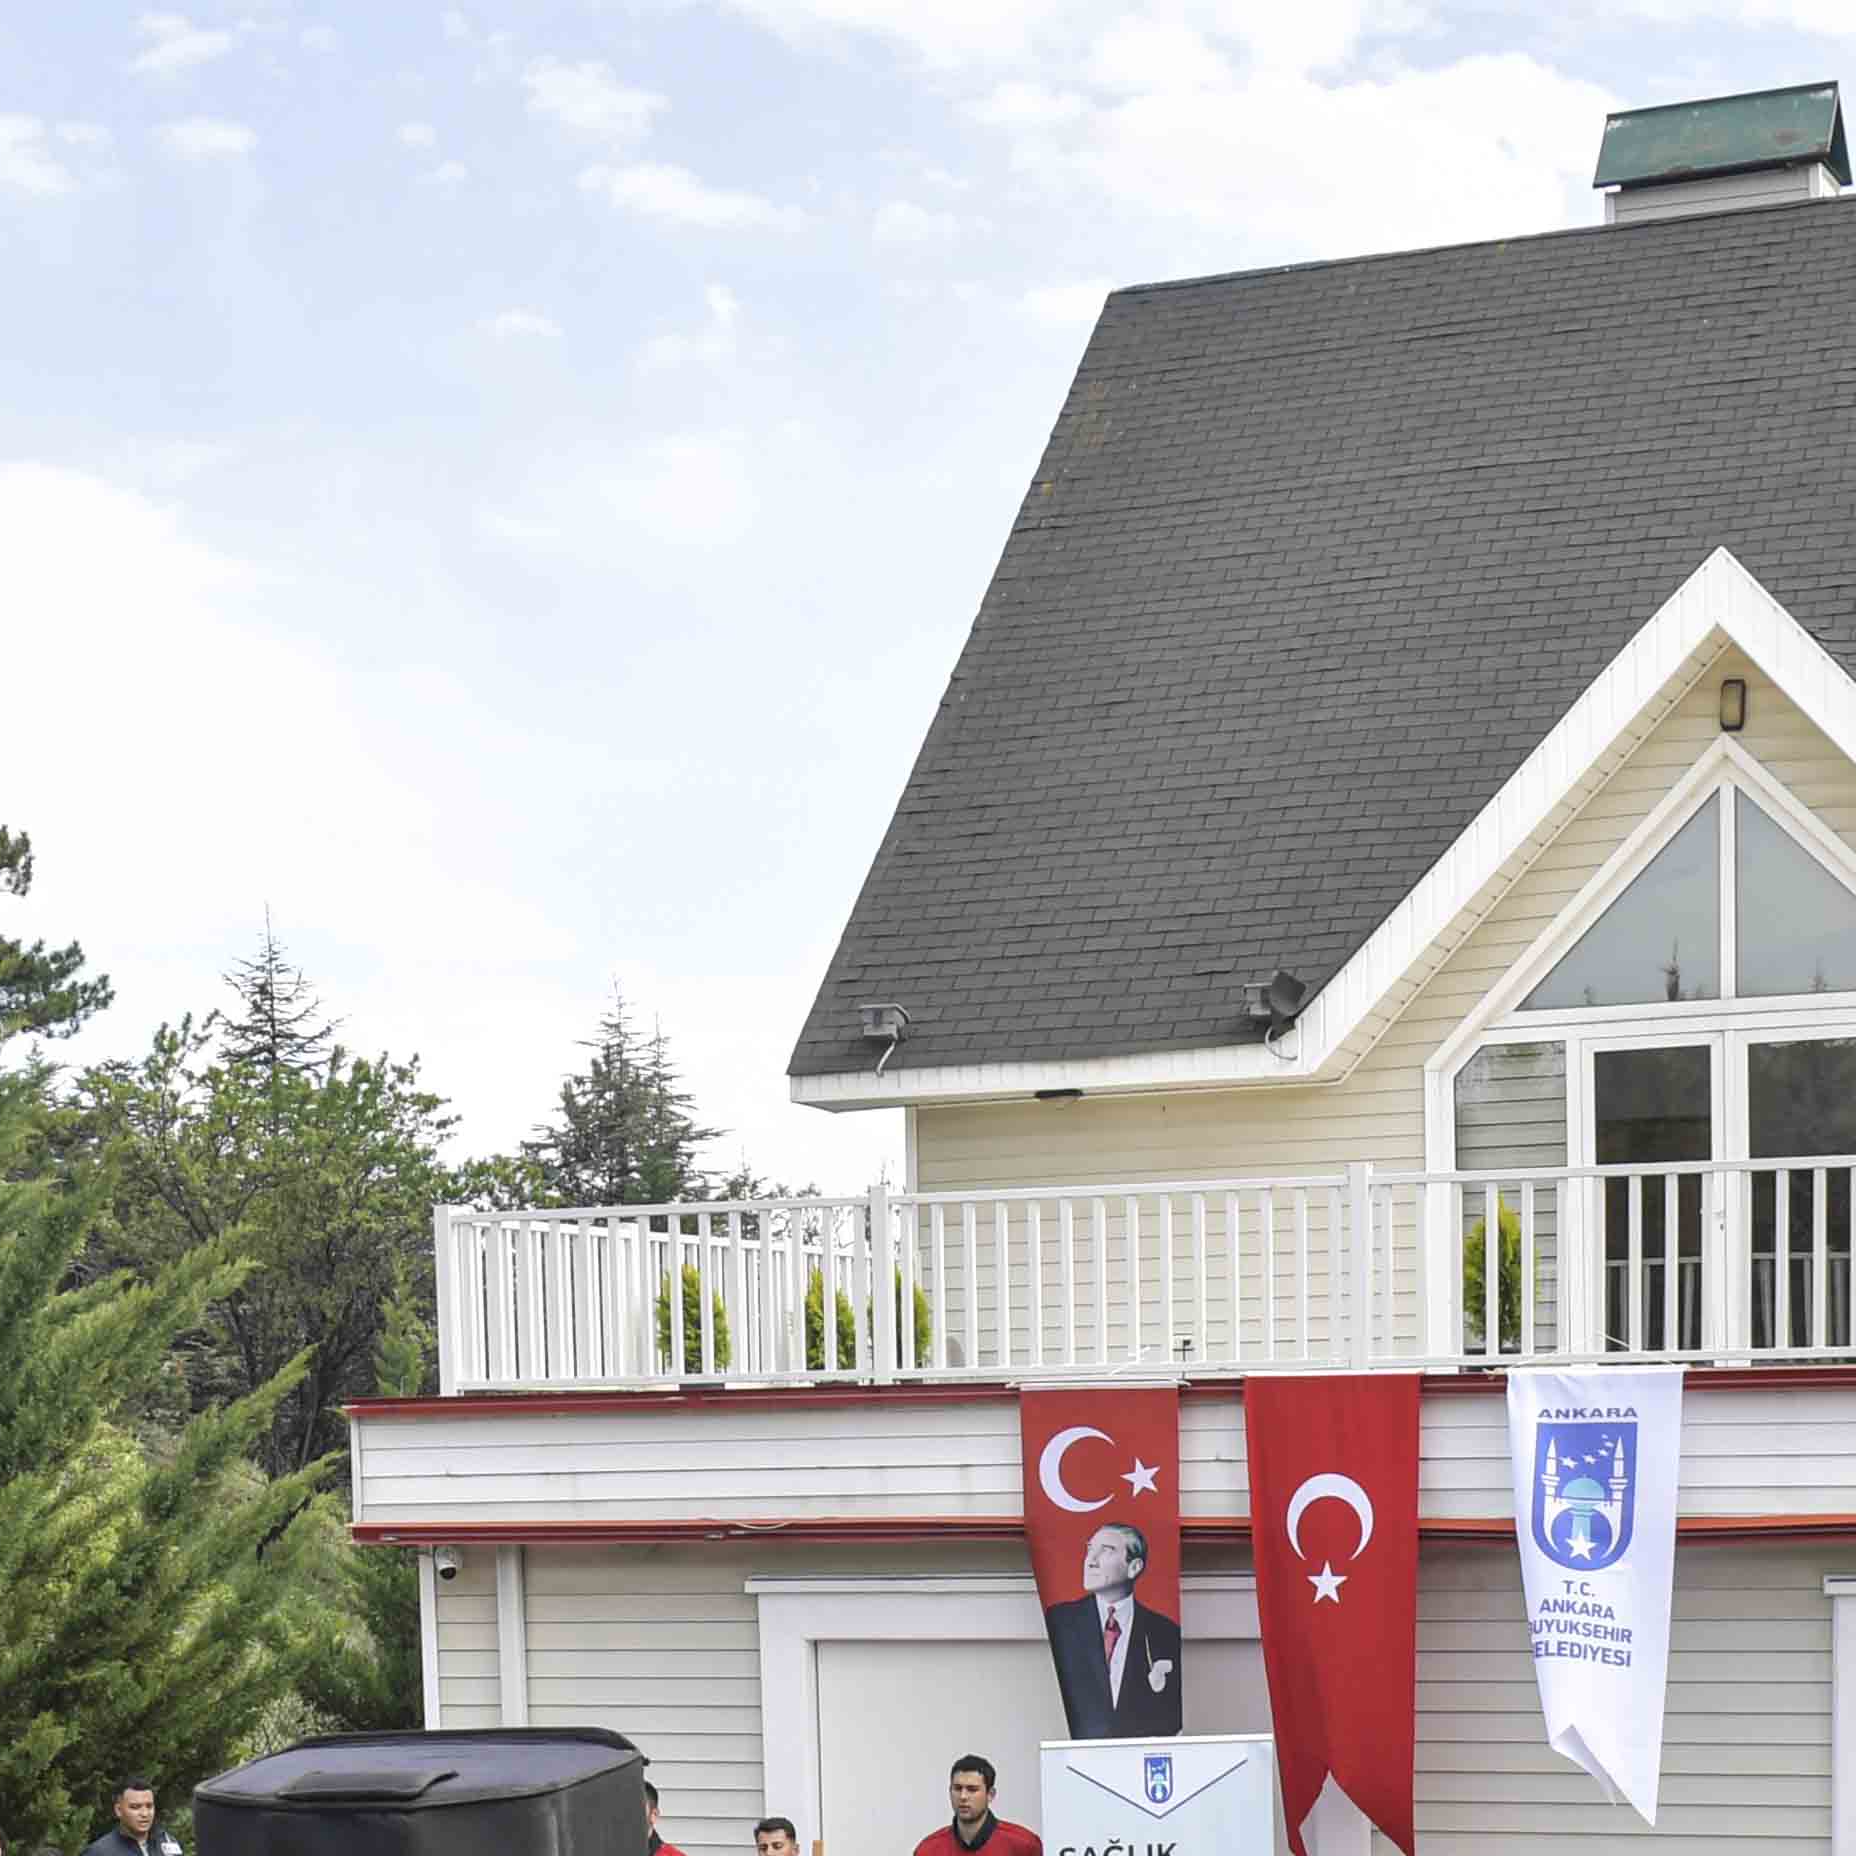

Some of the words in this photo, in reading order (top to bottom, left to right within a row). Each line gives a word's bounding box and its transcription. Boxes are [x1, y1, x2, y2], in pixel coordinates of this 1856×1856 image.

[1537, 1407, 1639, 1419] ANKARA
[1561, 1580, 1597, 1597] T.C.
[1539, 1598, 1617, 1621] ANKARA
